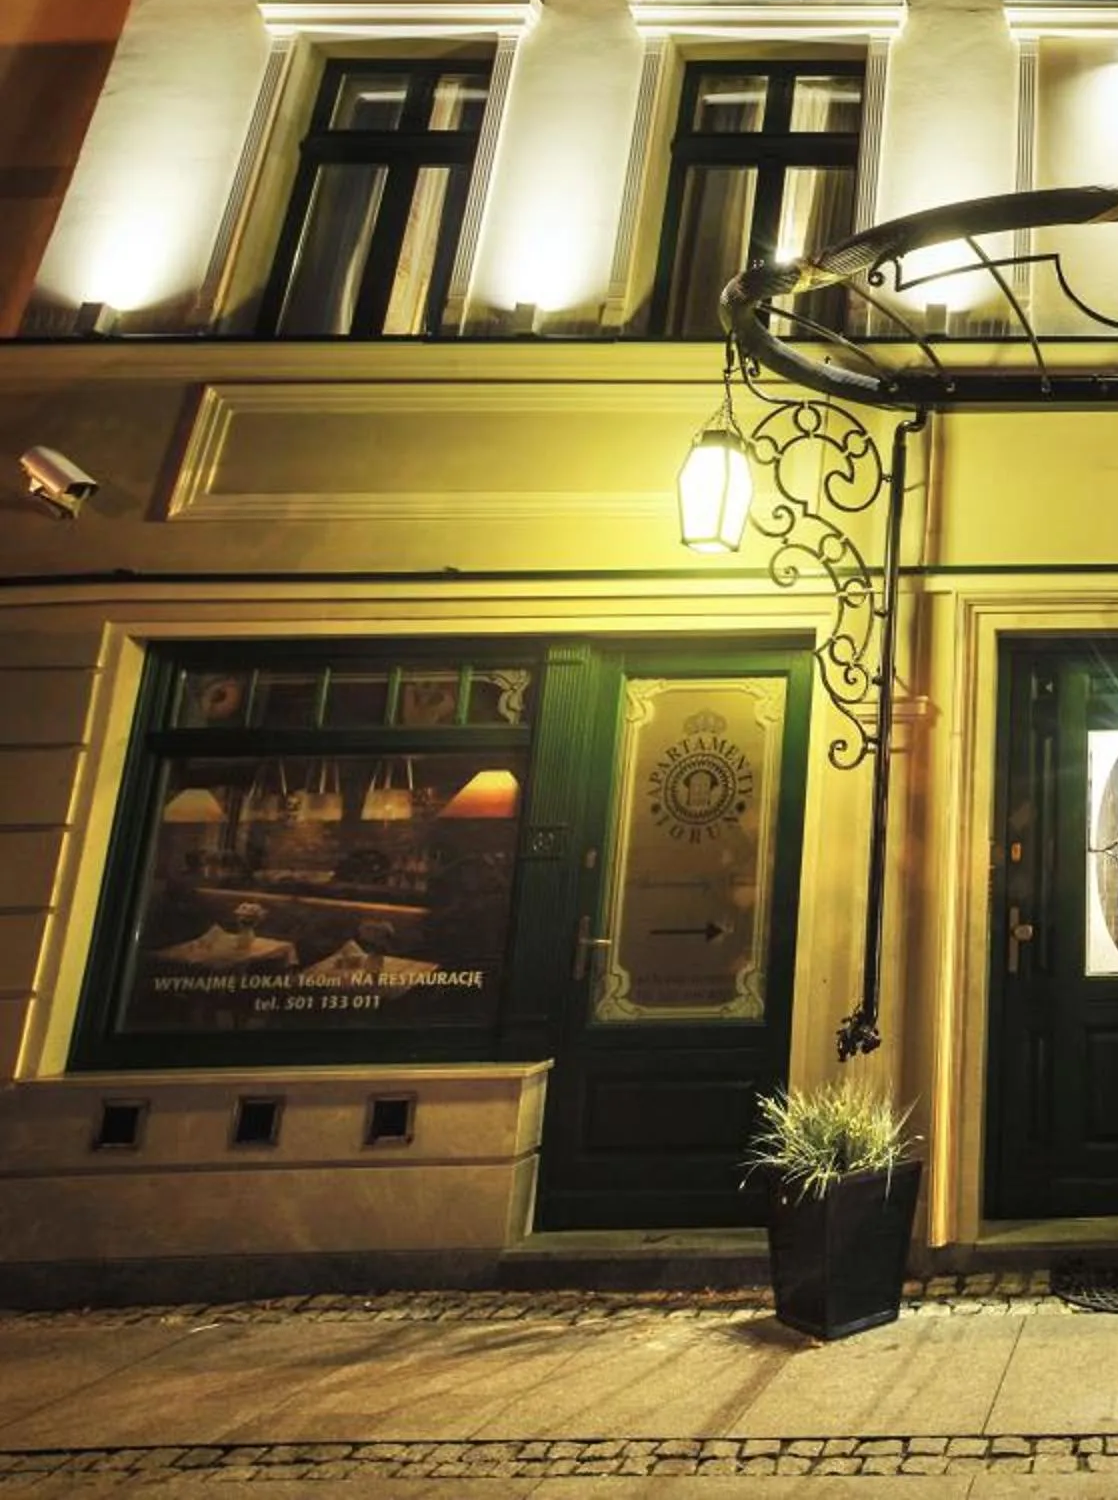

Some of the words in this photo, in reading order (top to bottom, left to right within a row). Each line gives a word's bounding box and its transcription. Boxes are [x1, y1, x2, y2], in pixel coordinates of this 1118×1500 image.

[241, 974, 292, 989] LOKAL
[351, 970, 374, 987] NA
[378, 970, 484, 989] RESTAURACJĘ
[255, 996, 280, 1011] tel.
[285, 996, 314, 1010] 501
[322, 995, 348, 1009] 133
[353, 995, 380, 1009] 011
